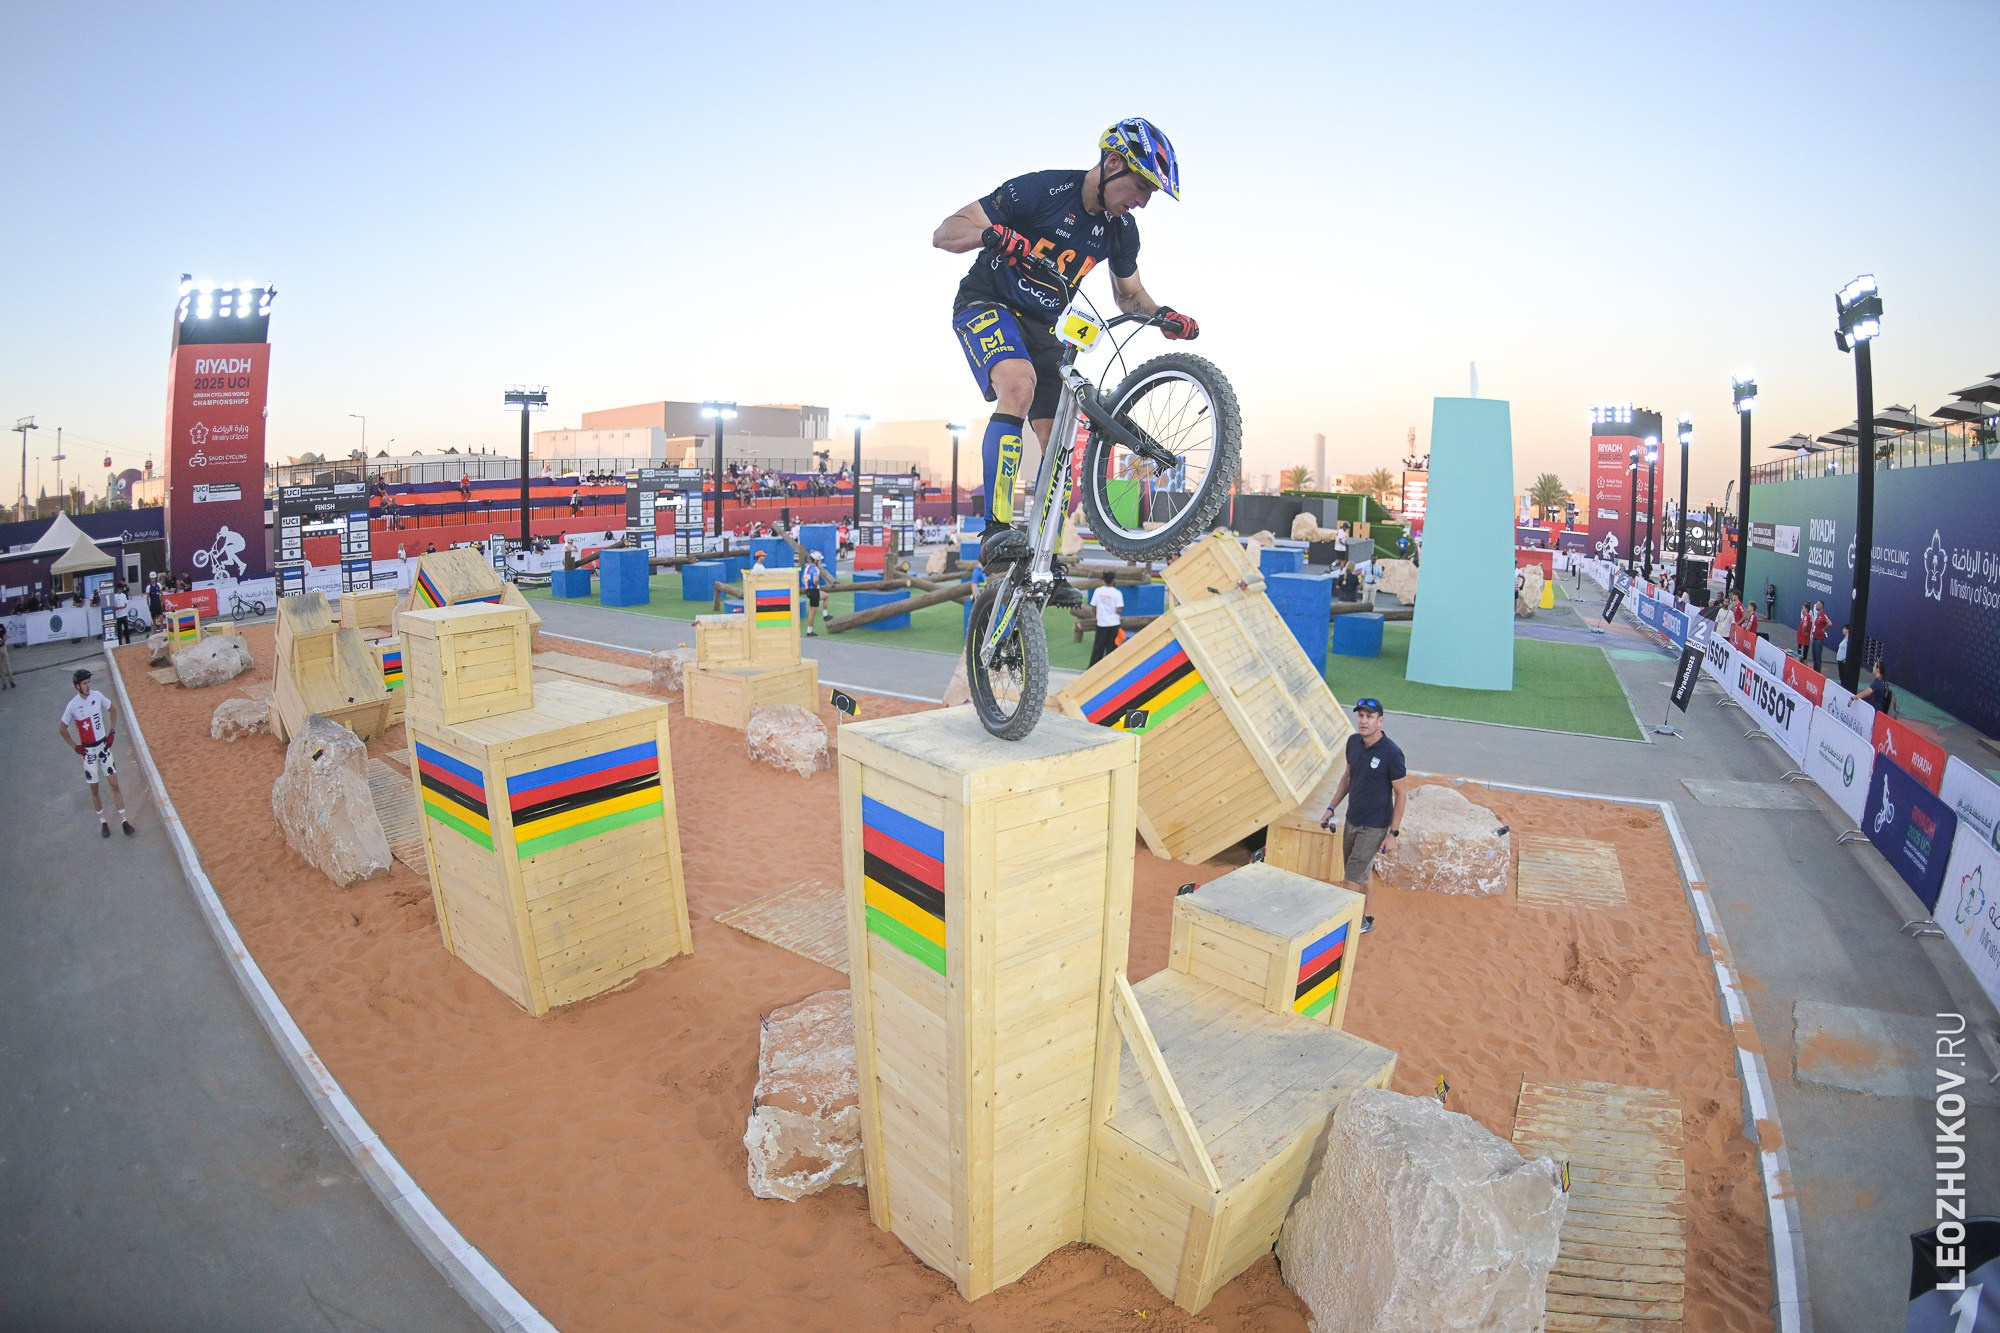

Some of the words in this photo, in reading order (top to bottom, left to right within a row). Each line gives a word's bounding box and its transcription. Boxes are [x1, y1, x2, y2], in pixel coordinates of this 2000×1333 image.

[1077, 325, 1090, 339] 4
[983, 345, 1015, 365] COMAS
[195, 358, 252, 375] RIYADH
[194, 377, 224, 390] 2025
[227, 376, 250, 389] UCI
[193, 398, 249, 406] CHAMPIONSHIPS
[1597, 443, 1623, 453] RIYADH
[1613, 453, 1623, 461] UCI
[286, 488, 300, 497] UCI
[315, 503, 335, 511] FINISH
[285, 516, 299, 525] UCI
[1810, 518, 1836, 543] RIYADH
[497, 546, 502, 556] 2
[1808, 545, 1823, 566] 2025
[1823, 548, 1834, 569] UCI
[1871, 546, 1883, 560] UDI
[1883, 548, 1910, 566] CYCLING
[1951, 548, 1981, 579] الرياضة
[356, 582, 369, 590] UCI
[1949, 578, 1974, 606] Ministry
[1974, 585, 1983, 604] of
[105, 594, 111, 607] 1
[1694, 621, 1708, 640] 2
[1691, 640, 1702, 650] UCI
[1676, 655, 1696, 700] #Riyadh2025
[1752, 674, 1795, 731] TISSOT
[1911, 751, 1933, 776] RIYADH
[1911, 805, 1936, 839] RIYADH
